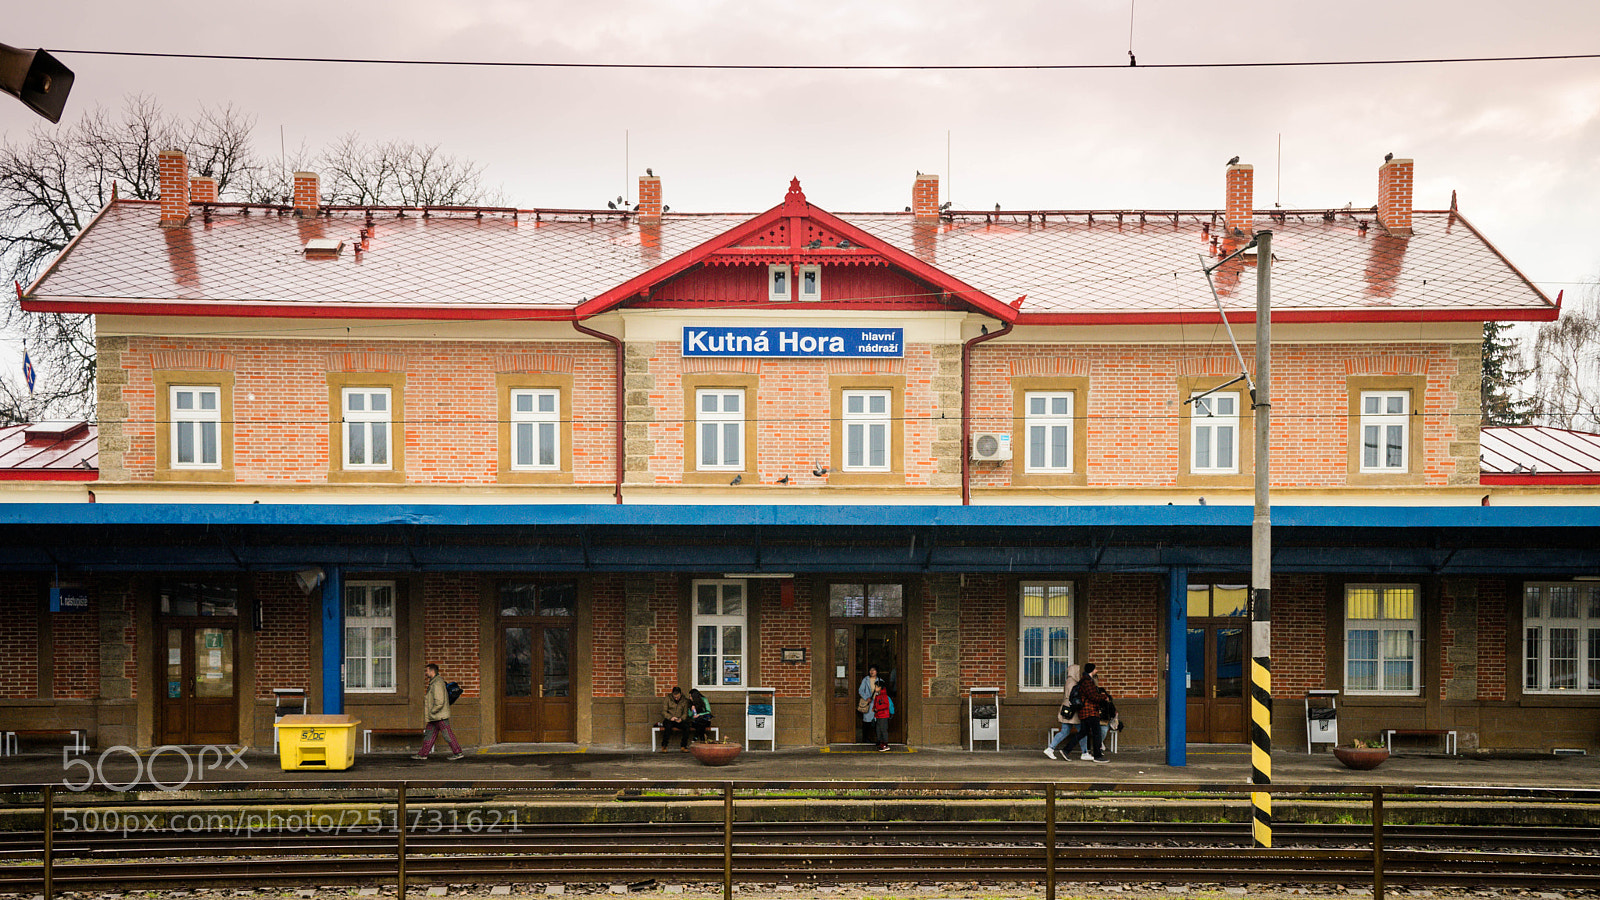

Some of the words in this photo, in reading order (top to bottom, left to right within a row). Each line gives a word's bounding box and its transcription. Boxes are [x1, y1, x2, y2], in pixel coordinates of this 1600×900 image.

[862, 331, 896, 341] hlavní
[688, 330, 769, 353] Kutná
[779, 331, 845, 353] Hora
[858, 343, 899, 353] nádraží
